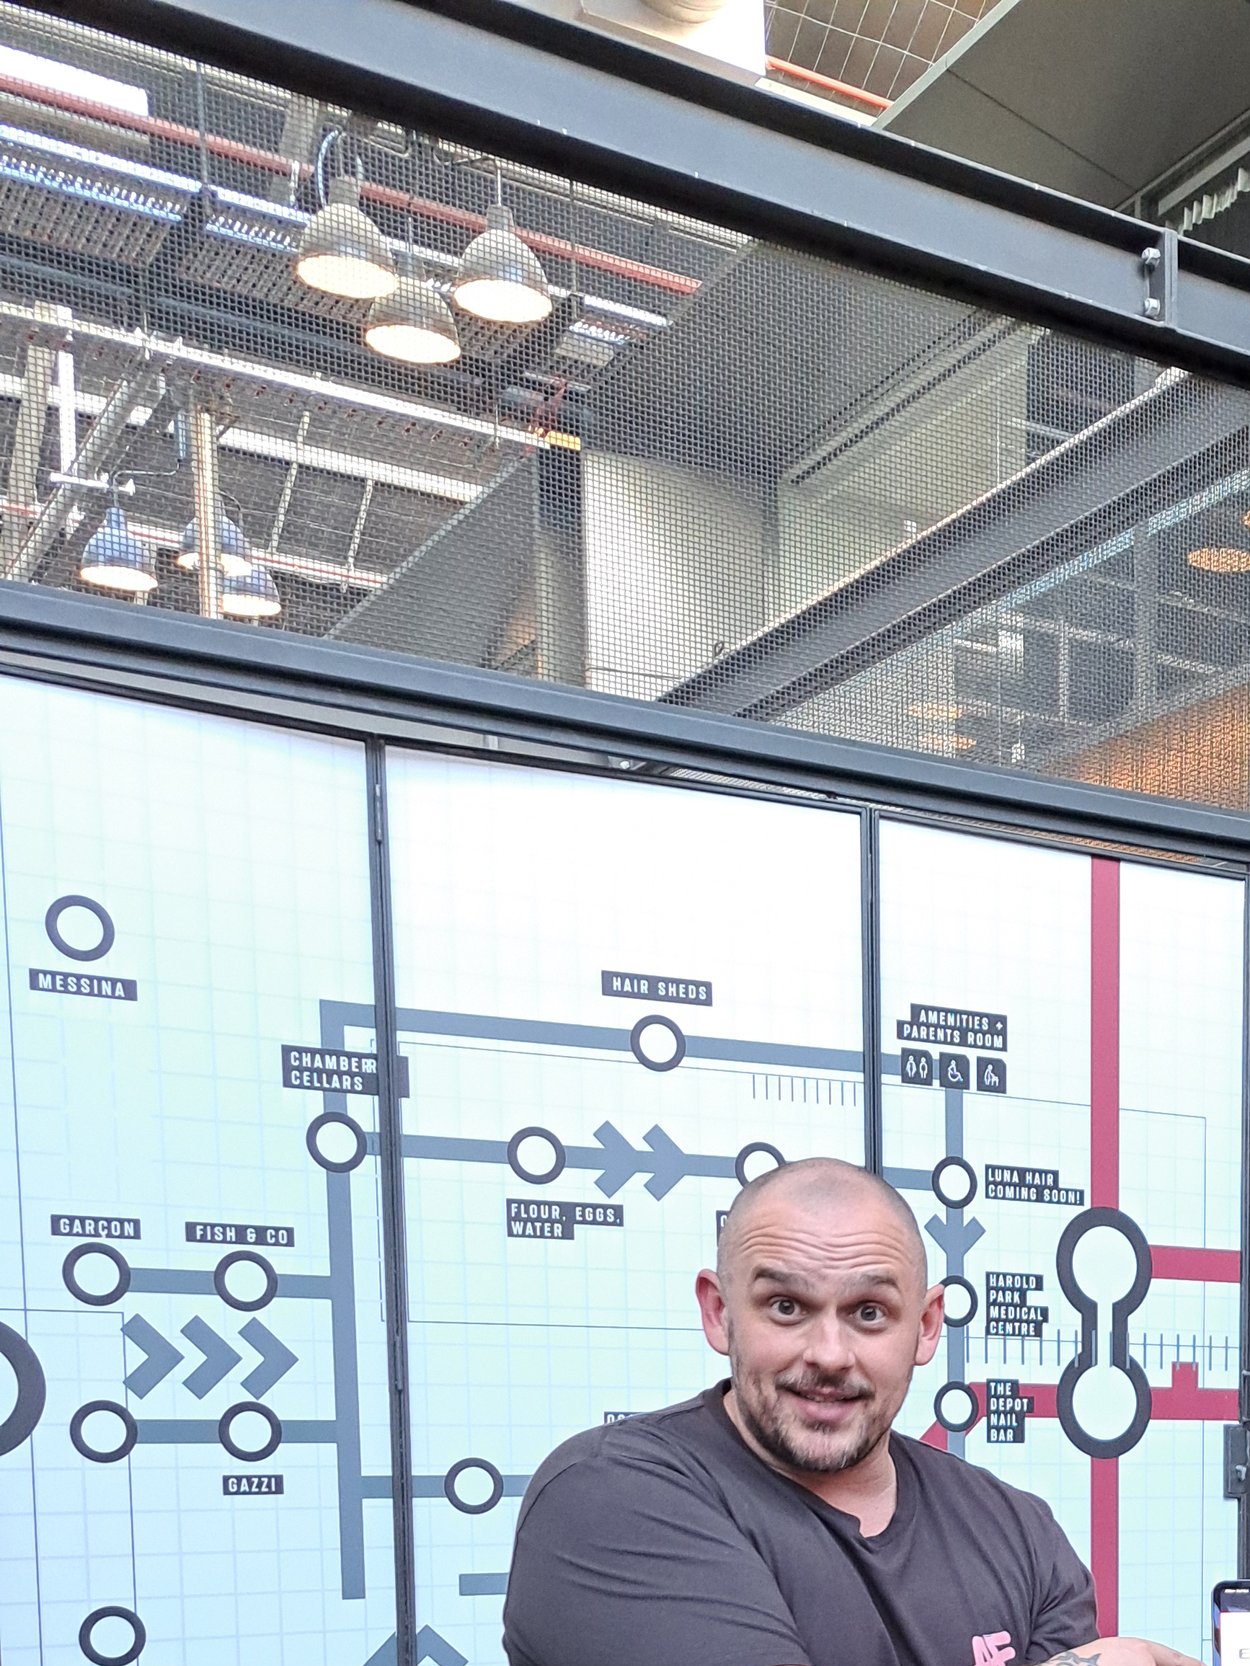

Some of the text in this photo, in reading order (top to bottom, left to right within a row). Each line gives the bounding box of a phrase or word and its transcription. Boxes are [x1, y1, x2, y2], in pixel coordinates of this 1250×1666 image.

[38, 973, 125, 997] MESSINA
[612, 976, 707, 1000] HAIR SHEDS
[919, 1009, 989, 1031] AMENITIES
[903, 1023, 1003, 1049] PARENTS ROOM
[291, 1070, 363, 1091] CELLARS
[988, 1168, 1054, 1186] LUNA HAIR
[988, 1184, 1080, 1204] COMING SOON!
[511, 1203, 620, 1225] FLOUR, EGGS,
[59, 1218, 135, 1239] GARÇON
[196, 1225, 288, 1244] FISH & CO
[511, 1221, 562, 1238] WATER
[990, 1274, 1036, 1289] HAROLD
[990, 1290, 1020, 1305] PARK
[990, 1306, 1044, 1320] MEDICAL
[990, 1321, 1036, 1336] CENTRE
[990, 1382, 1012, 1396] THE
[990, 1398, 1028, 1412] DEPOT
[990, 1413, 1018, 1427] NAIL
[990, 1429, 1014, 1442] BAR
[228, 1477, 276, 1492] GAZZI
